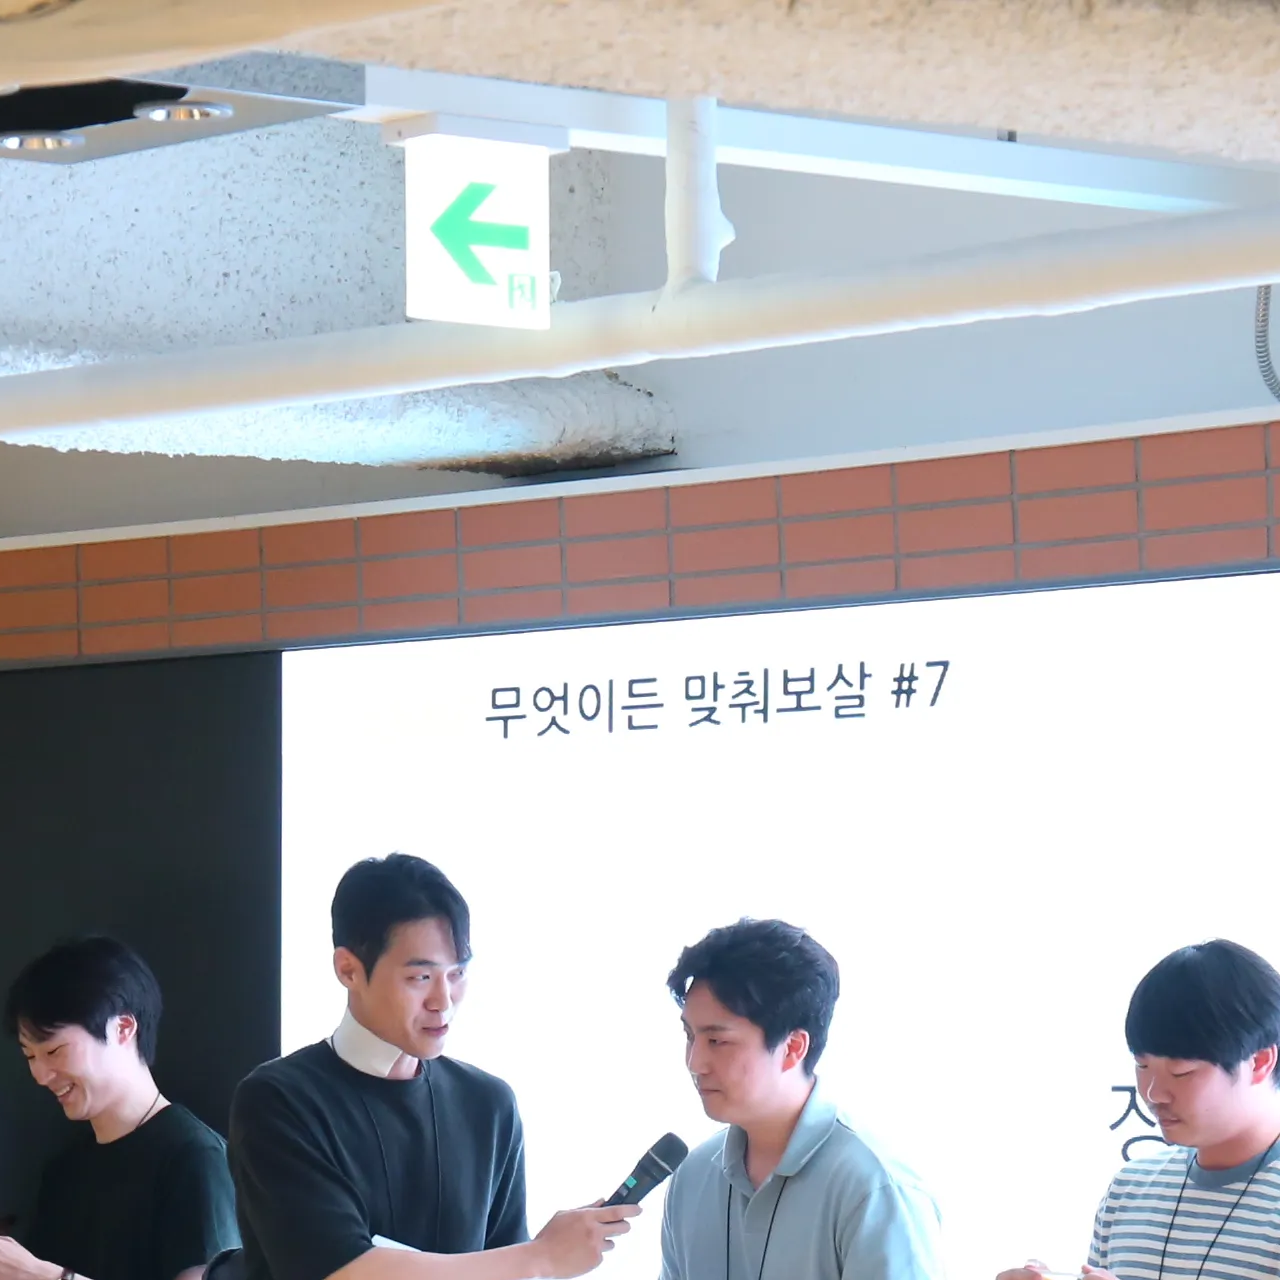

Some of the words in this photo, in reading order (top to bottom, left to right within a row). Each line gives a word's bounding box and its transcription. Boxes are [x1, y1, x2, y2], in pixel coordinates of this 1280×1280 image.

[485, 677, 664, 739] 무엇이든
[684, 660, 873, 728] 맞춰보살
[890, 660, 951, 709] #7
